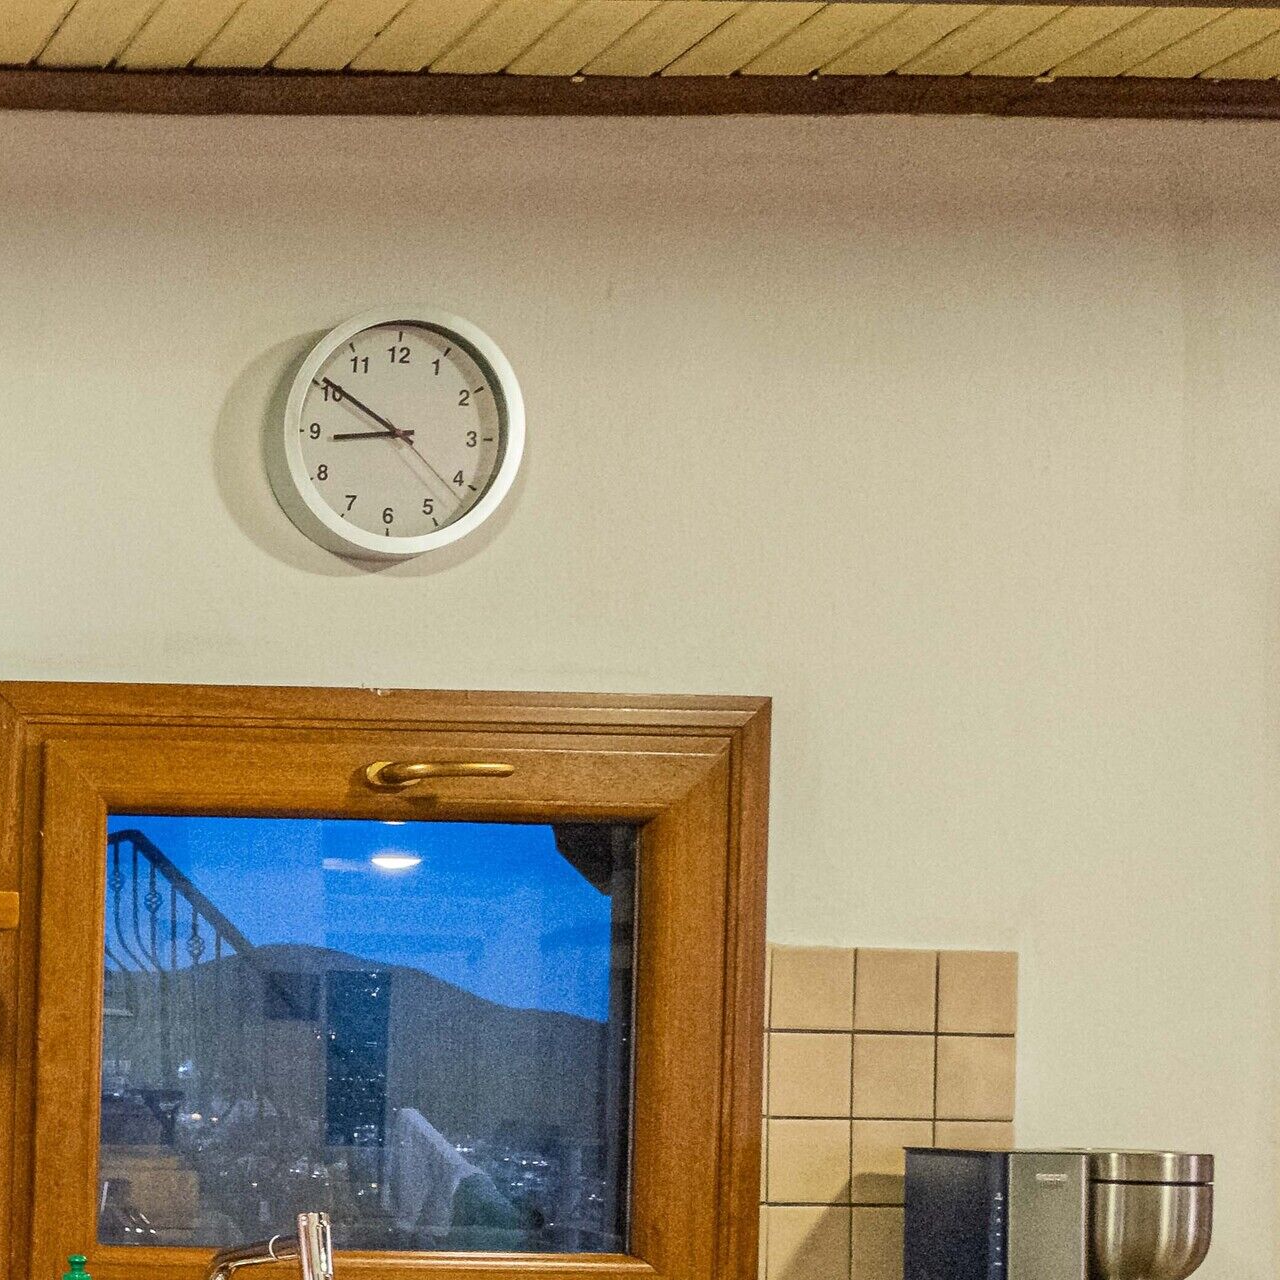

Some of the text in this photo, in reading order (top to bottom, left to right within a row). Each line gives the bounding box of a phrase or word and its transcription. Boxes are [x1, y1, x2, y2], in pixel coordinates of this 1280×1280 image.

[388, 347, 410, 364] 12
[350, 357, 369, 374] 11
[432, 358, 440, 375] 1
[321, 384, 343, 402] 10
[458, 390, 470, 406] 2
[309, 423, 321, 439] 9
[466, 431, 477, 447] 3
[317, 464, 328, 480] 8
[453, 470, 464, 487] 4
[345, 495, 357, 511] 7
[422, 499, 434, 515] 5
[382, 507, 394, 524] 6
